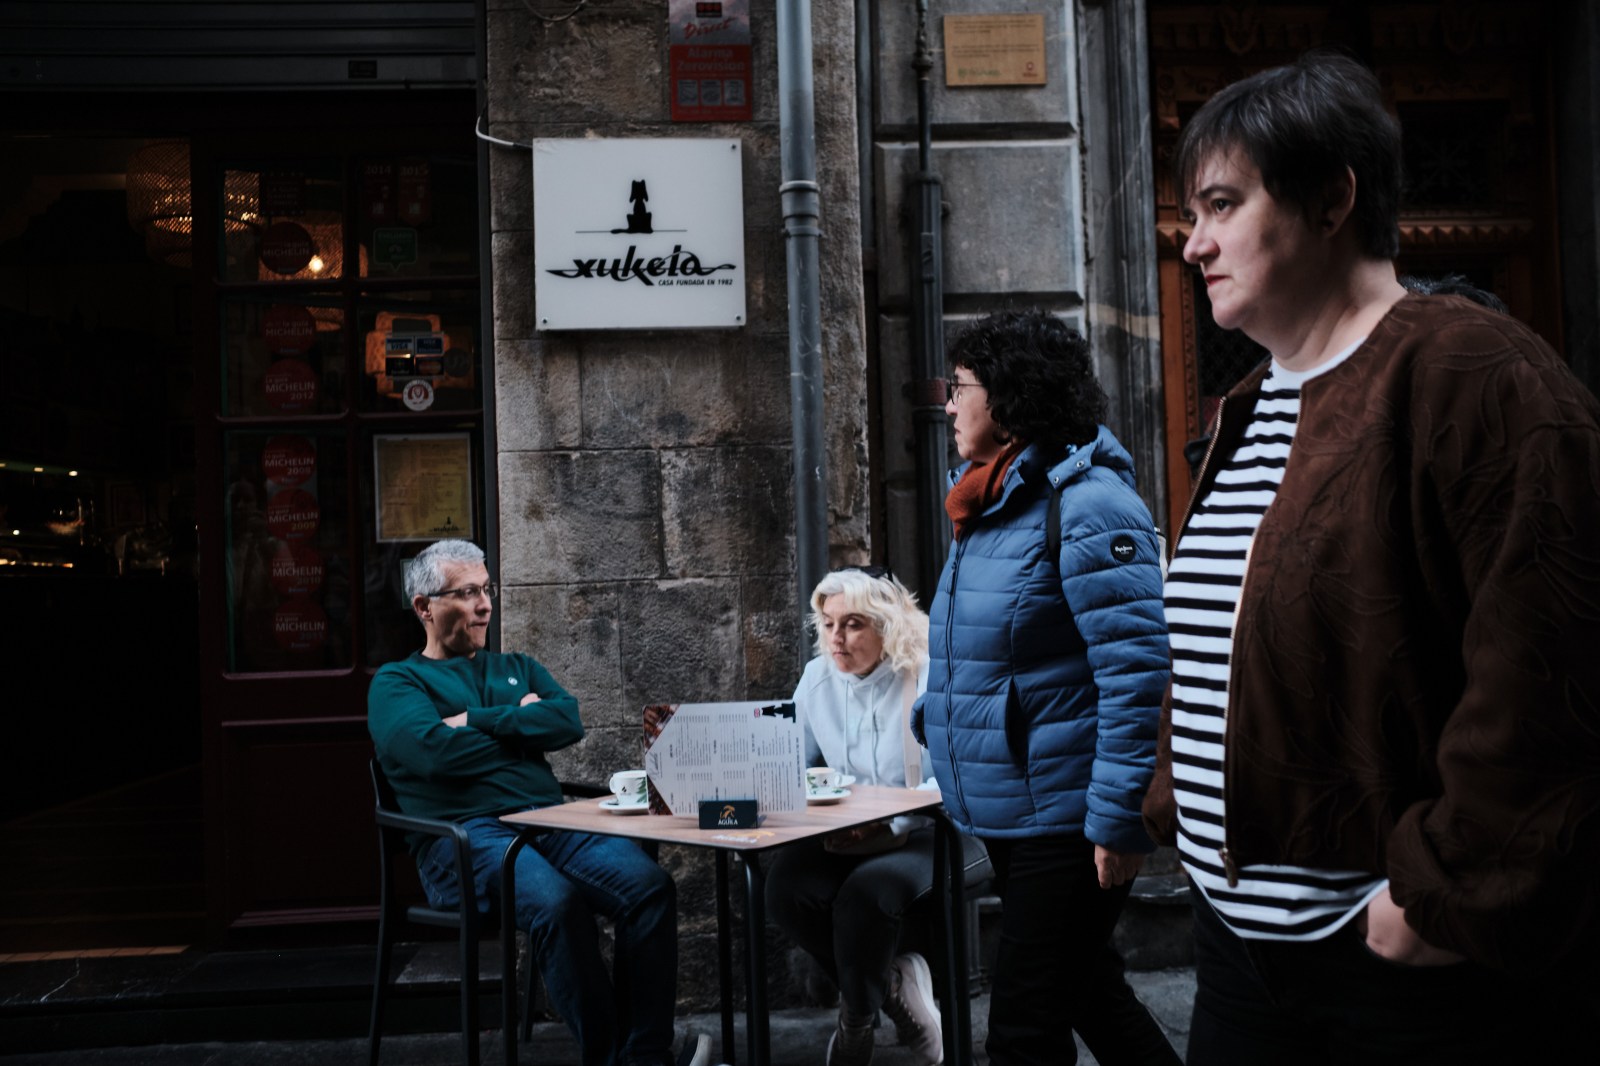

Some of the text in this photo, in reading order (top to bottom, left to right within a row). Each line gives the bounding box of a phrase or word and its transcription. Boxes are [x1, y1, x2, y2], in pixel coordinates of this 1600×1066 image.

[687, 47, 734, 58] Alarma
[364, 165, 392, 176] 2014
[400, 163, 429, 176] 2015
[263, 248, 310, 257] MICHELIN
[546, 245, 736, 286] xukela
[676, 278, 705, 286] FUNDADA
[707, 278, 716, 286] EN
[718, 278, 733, 286] 1982
[265, 327, 313, 337] MICHELIN
[265, 381, 315, 393] MICHELIN
[290, 392, 314, 401] 2012
[265, 457, 314, 468] MICHELIN
[268, 511, 318, 524] MICHELIN
[273, 565, 322, 577] MICHELIN
[275, 621, 325, 632] MICHELIN
